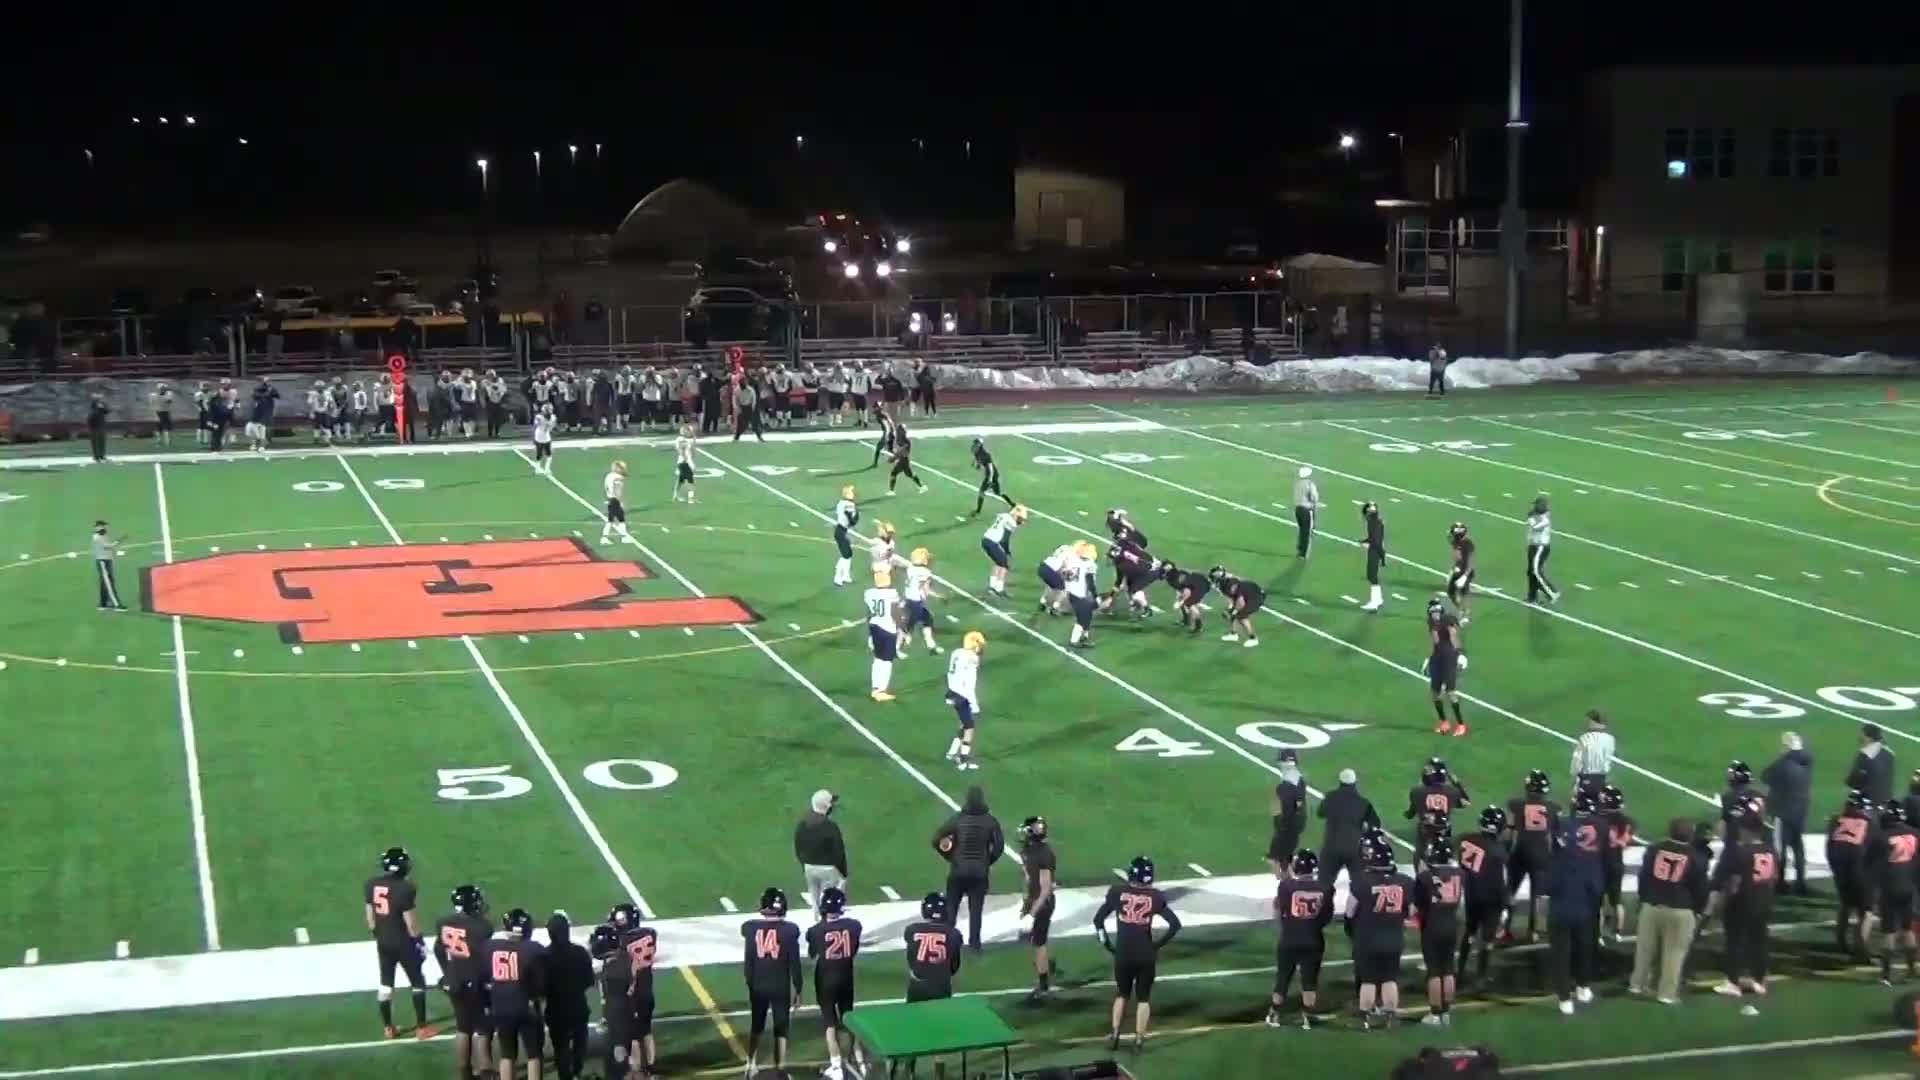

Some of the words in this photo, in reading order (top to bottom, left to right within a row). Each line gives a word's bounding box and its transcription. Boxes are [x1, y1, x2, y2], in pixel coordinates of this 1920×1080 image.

[373, 885, 390, 915] 5
[1119, 892, 1153, 924] 32
[1371, 884, 1403, 913] 79
[754, 928, 780, 959] 14
[824, 929, 850, 959] 21
[913, 932, 946, 963] 75
[491, 949, 520, 982] 61
